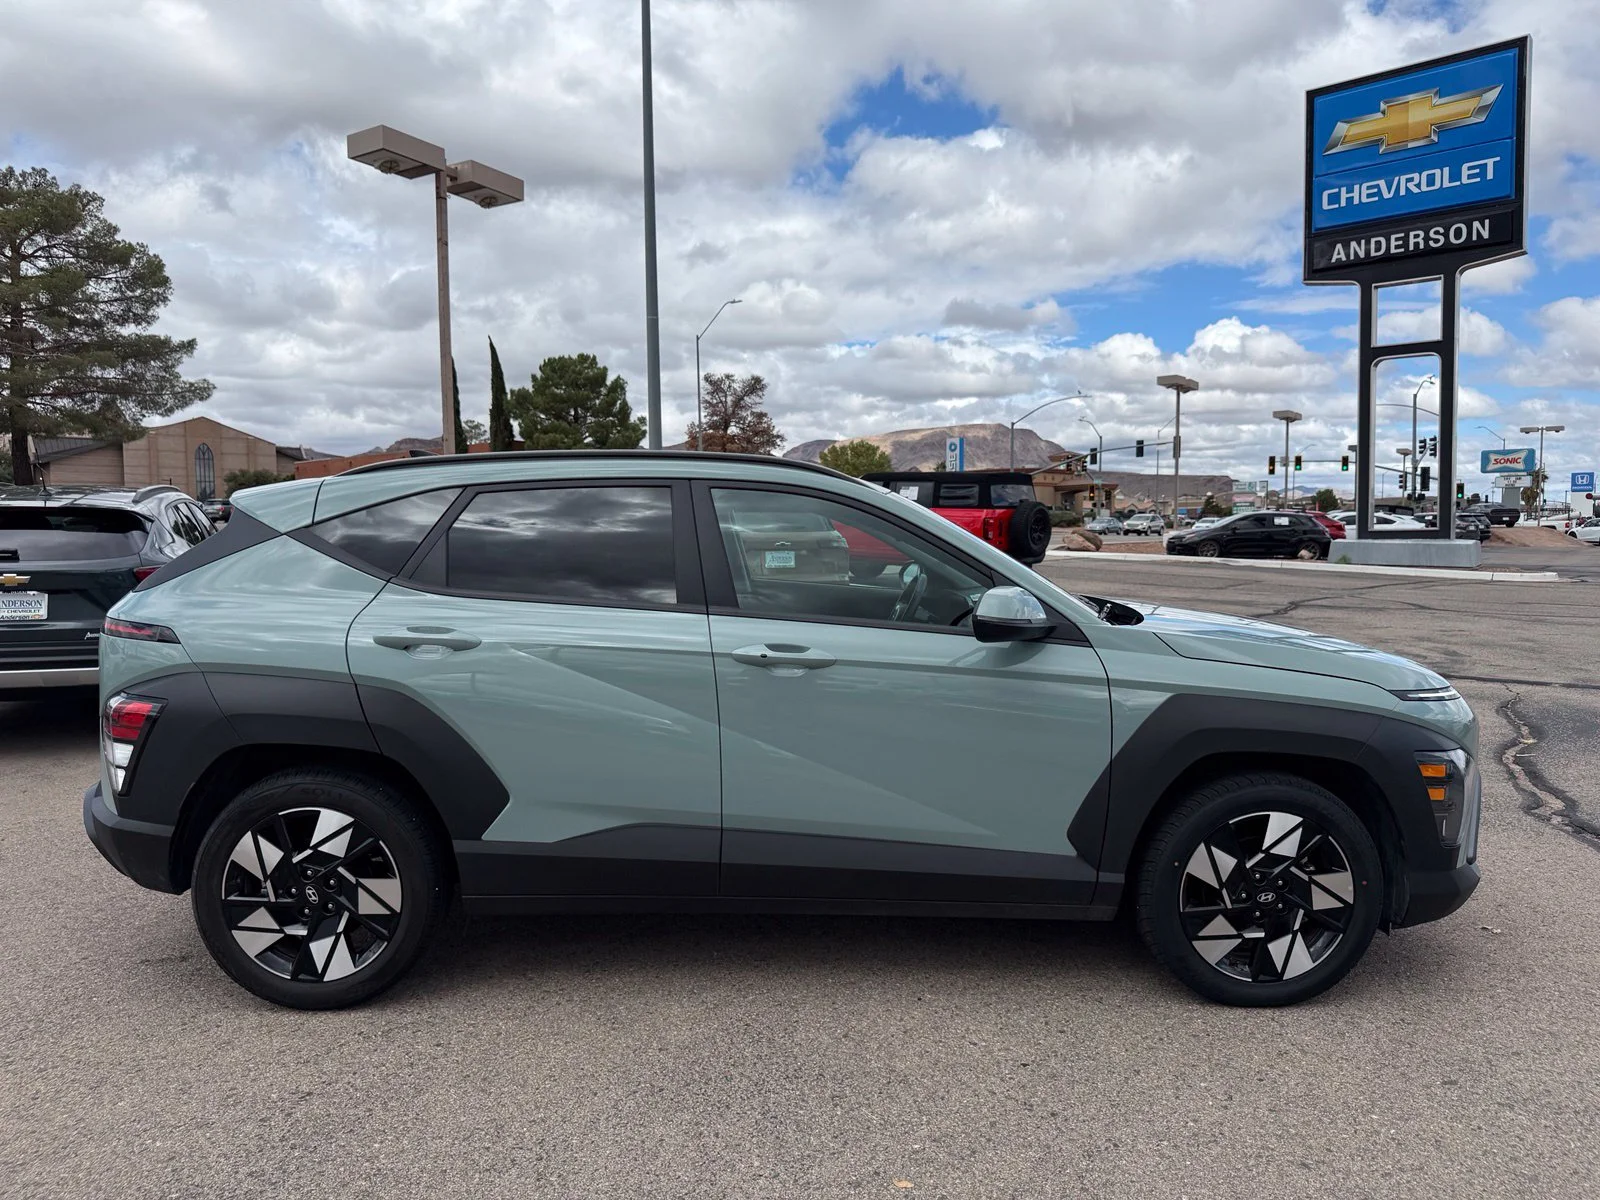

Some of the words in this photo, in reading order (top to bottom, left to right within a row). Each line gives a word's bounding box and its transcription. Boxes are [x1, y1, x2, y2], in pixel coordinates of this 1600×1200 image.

[1322, 157, 1500, 210] CHEVROLET
[1331, 219, 1490, 263] ANDERSON
[1492, 457, 1522, 465] SONIC
